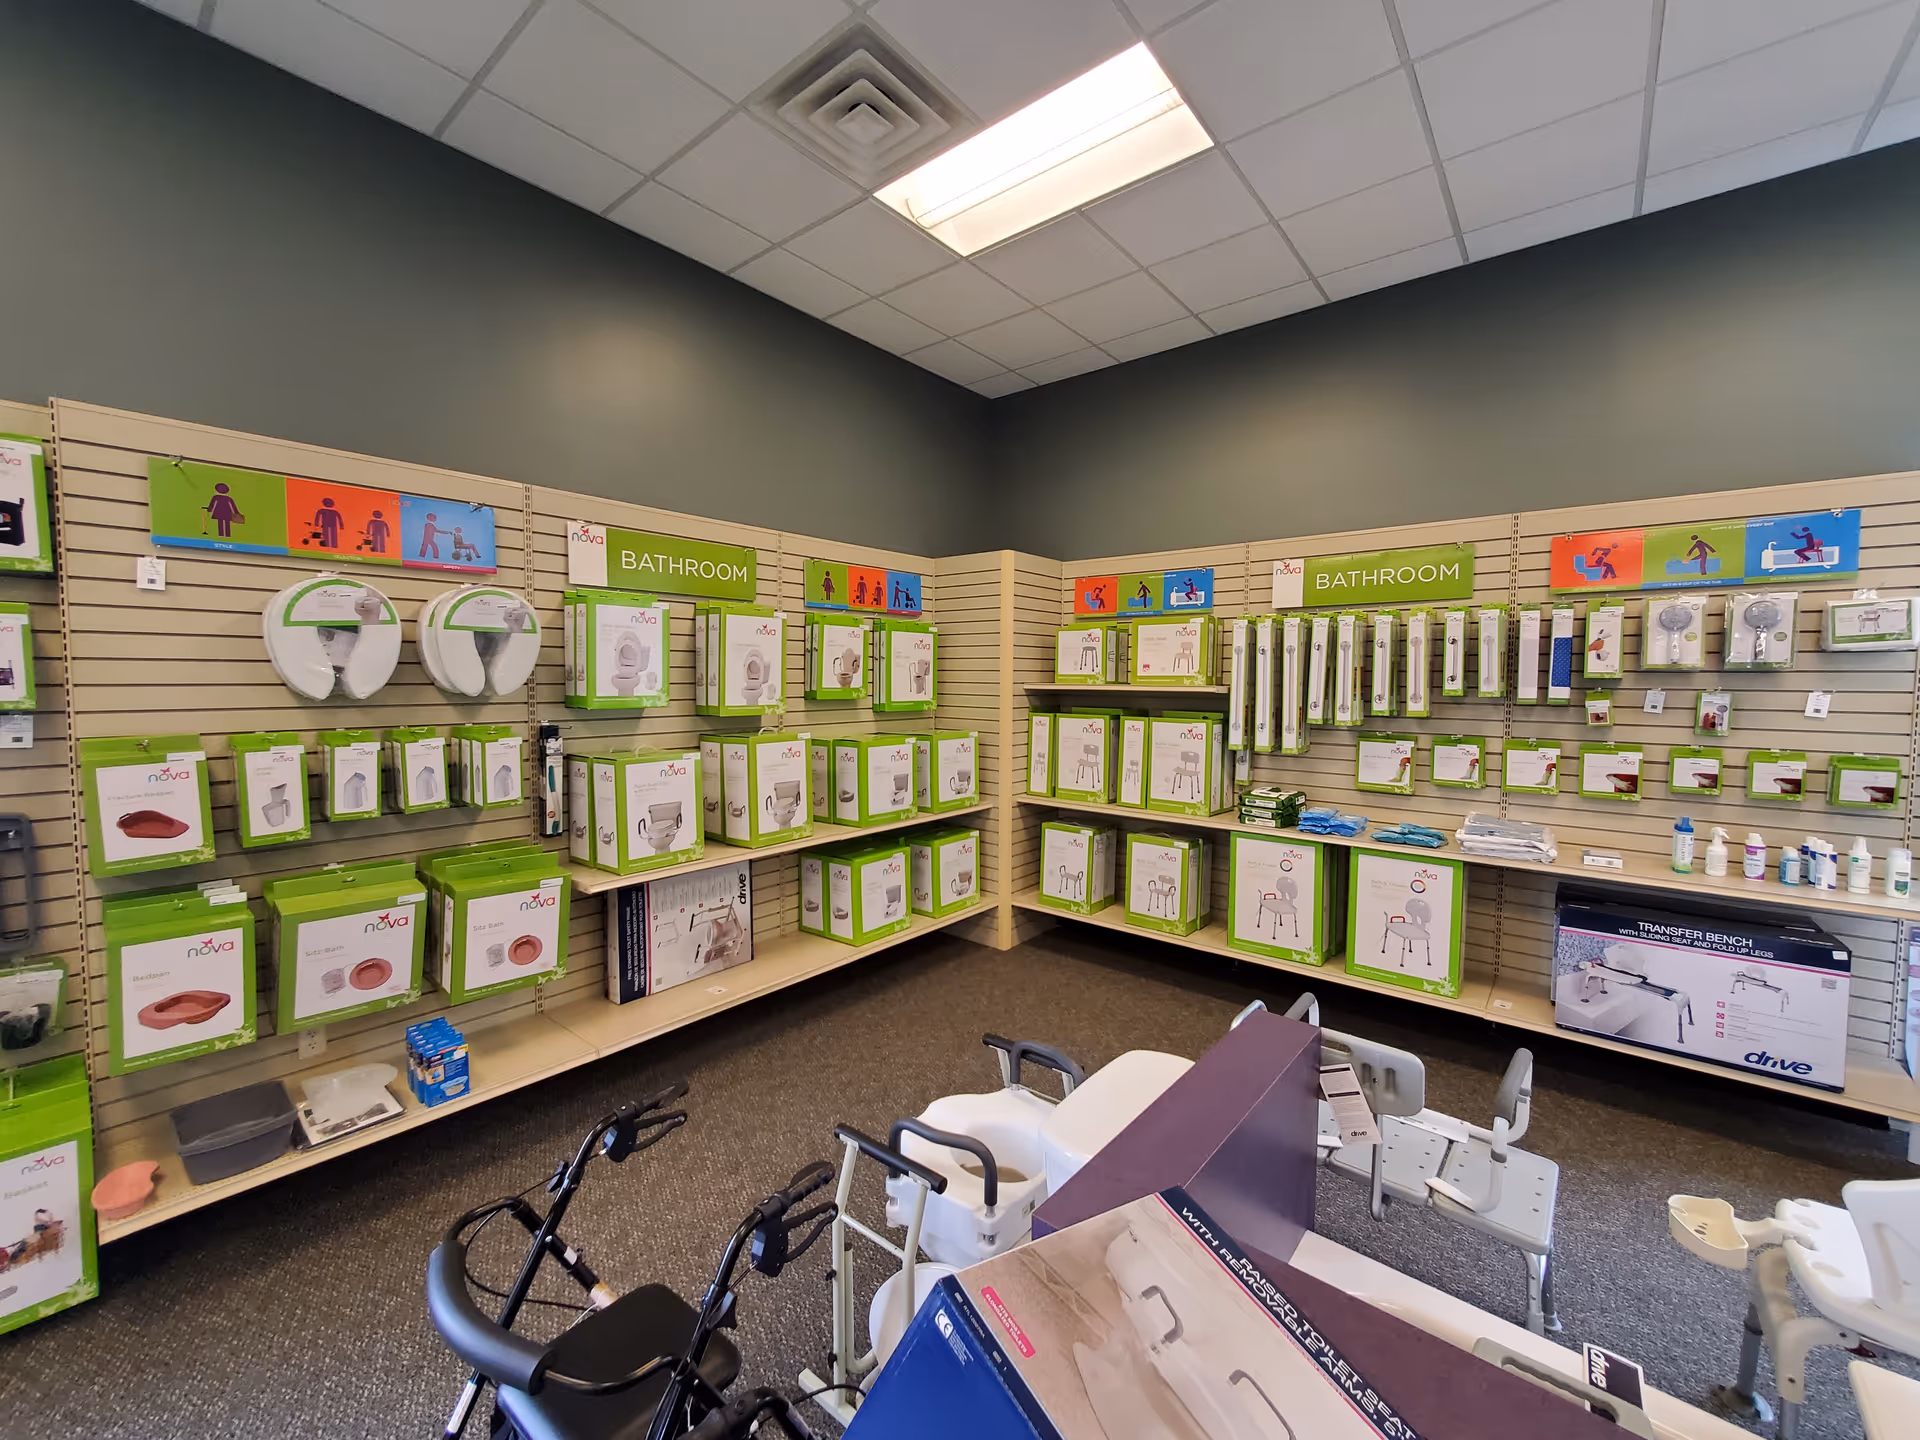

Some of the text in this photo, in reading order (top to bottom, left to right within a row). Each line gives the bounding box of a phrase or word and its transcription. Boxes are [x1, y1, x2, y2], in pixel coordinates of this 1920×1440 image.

[571, 528, 604, 545] nova
[621, 550, 748, 583] BATHROOM
[1275, 563, 1302, 576] nova
[1316, 563, 1460, 590] BATHROOM
[1082, 723, 1102, 734] nova
[1180, 728, 1203, 741] nova
[890, 749, 909, 762] nova
[148, 767, 190, 784] nova
[660, 763, 686, 777] nova
[1283, 850, 1303, 860] nova
[1414, 868, 1438, 881] nova
[738, 873, 747, 905] drive
[520, 892, 556, 911] nova
[363, 912, 409, 934] nova
[1618, 928, 1774, 959] WITH SLIDING SEAT AND FOLD UP LEGS
[1637, 921, 1753, 948] TRANSFER BENCH
[187, 938, 234, 958] nova
[132, 970, 171, 982] Bedpan
[1743, 1051, 1813, 1075] drive
[21, 1156, 65, 1175] nova
[985, 1293, 1010, 1329] ELONGATED
[1009, 1328, 1028, 1353] TOILETS
[998, 1304, 1021, 1335] FITS MOST
[1181, 1207, 1219, 1247] WITH
[1219, 1248, 1319, 1353] REMOVABLE
[1319, 1356, 1378, 1420] ARMS,
[1239, 1258, 1299, 1319] RAISED
[1301, 1319, 1362, 1385] TOILET
[1364, 1388, 1417, 1439] SEAT
[1590, 1349, 1610, 1389] drive
